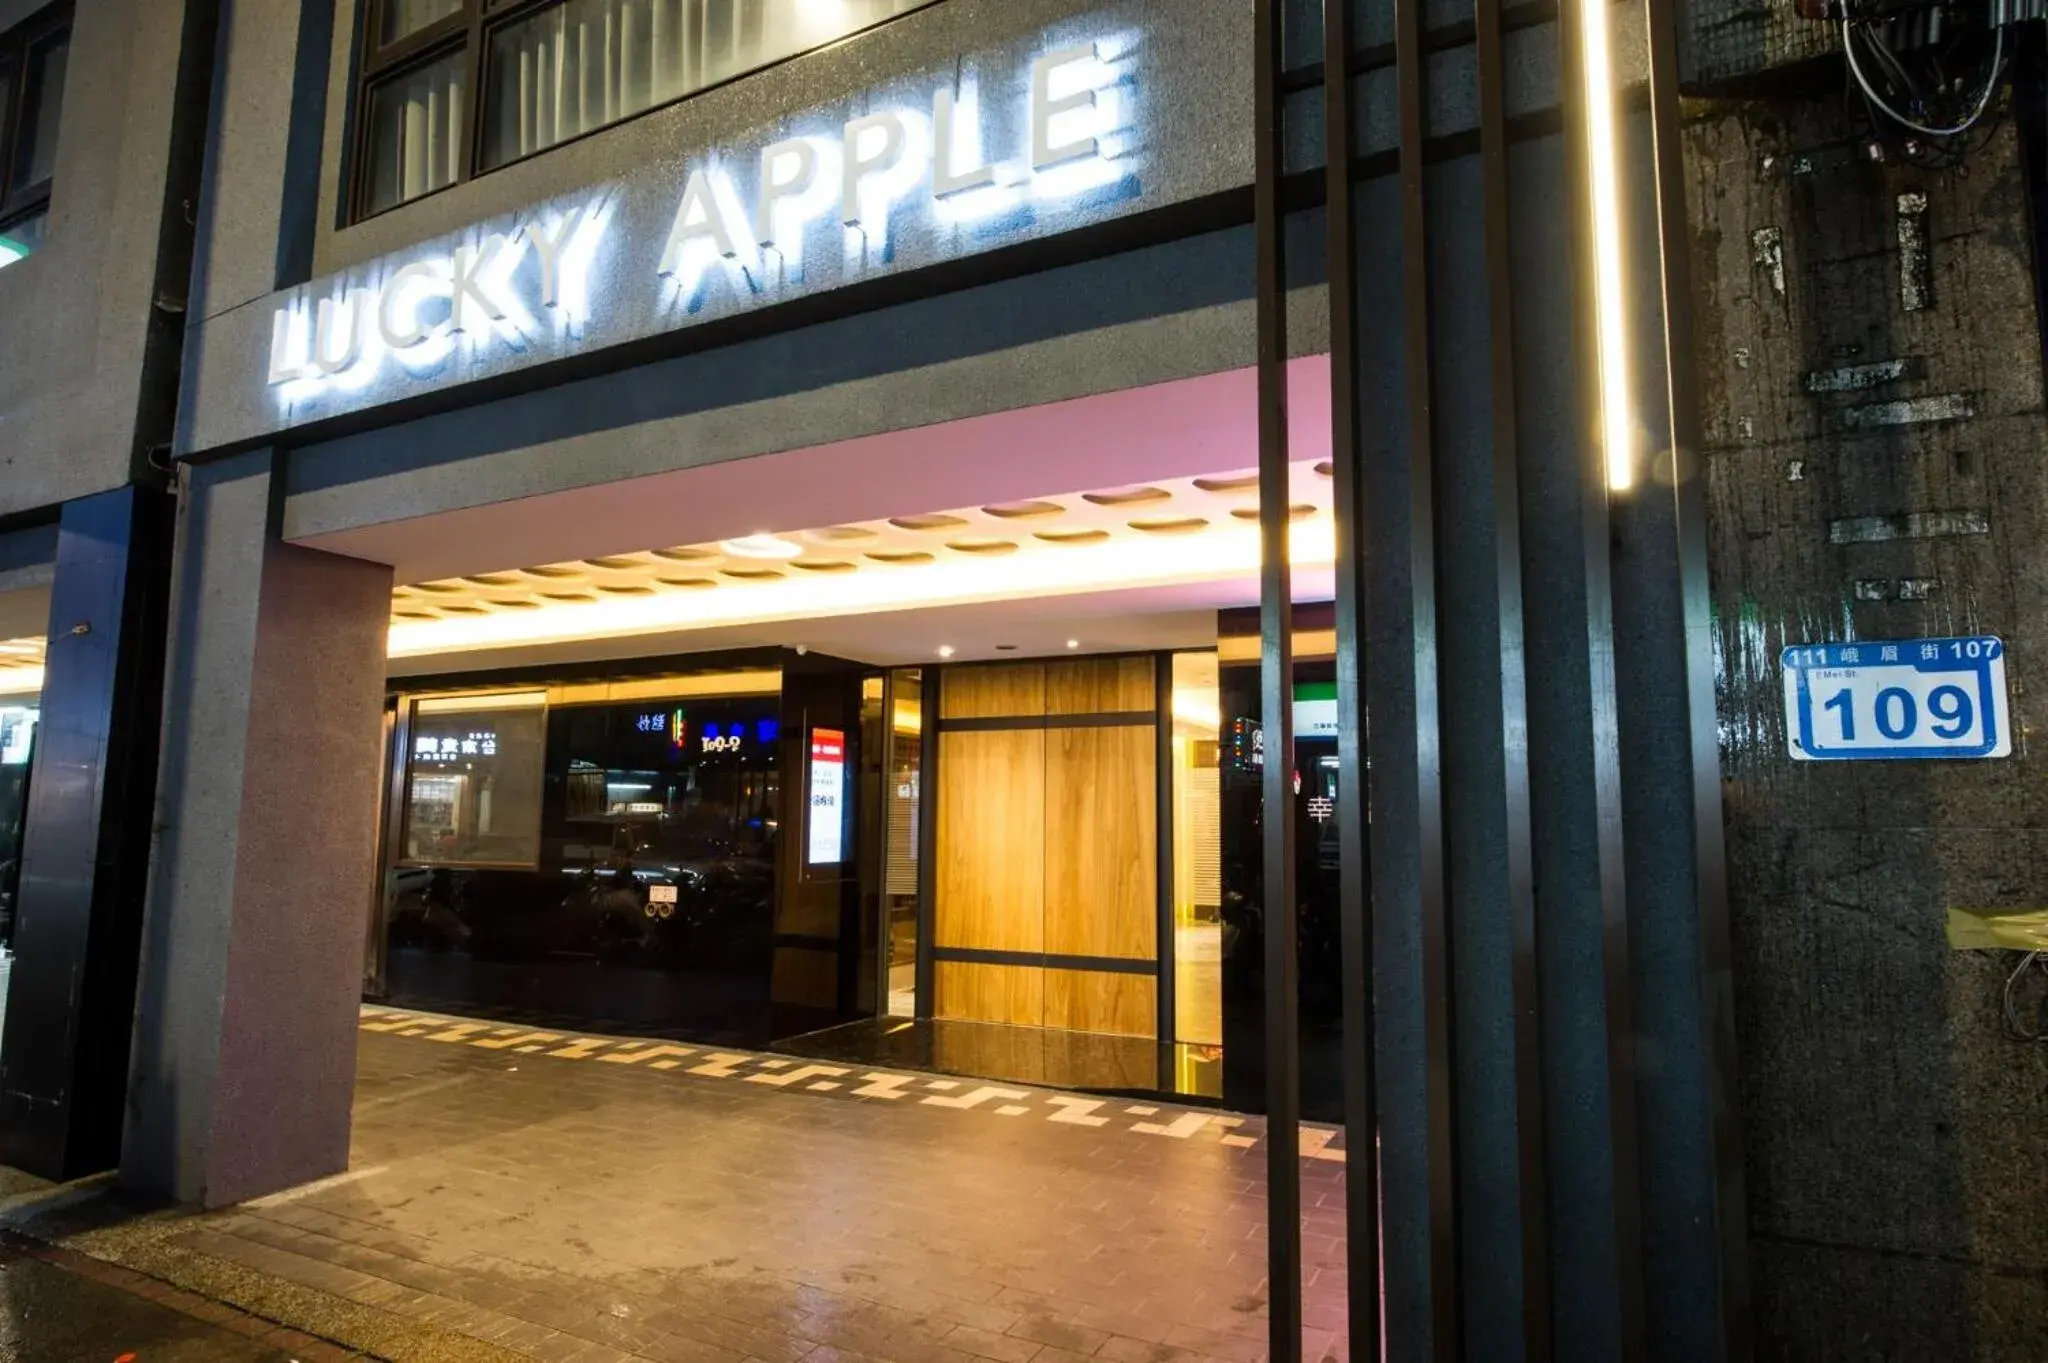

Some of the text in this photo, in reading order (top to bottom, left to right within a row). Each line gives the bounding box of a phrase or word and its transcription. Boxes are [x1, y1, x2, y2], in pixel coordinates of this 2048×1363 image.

[267, 42, 1100, 386] LUCKY APPLE
[1788, 648, 1827, 666] 111
[1950, 639, 1998, 660] 107
[1823, 684, 1974, 741] 109
